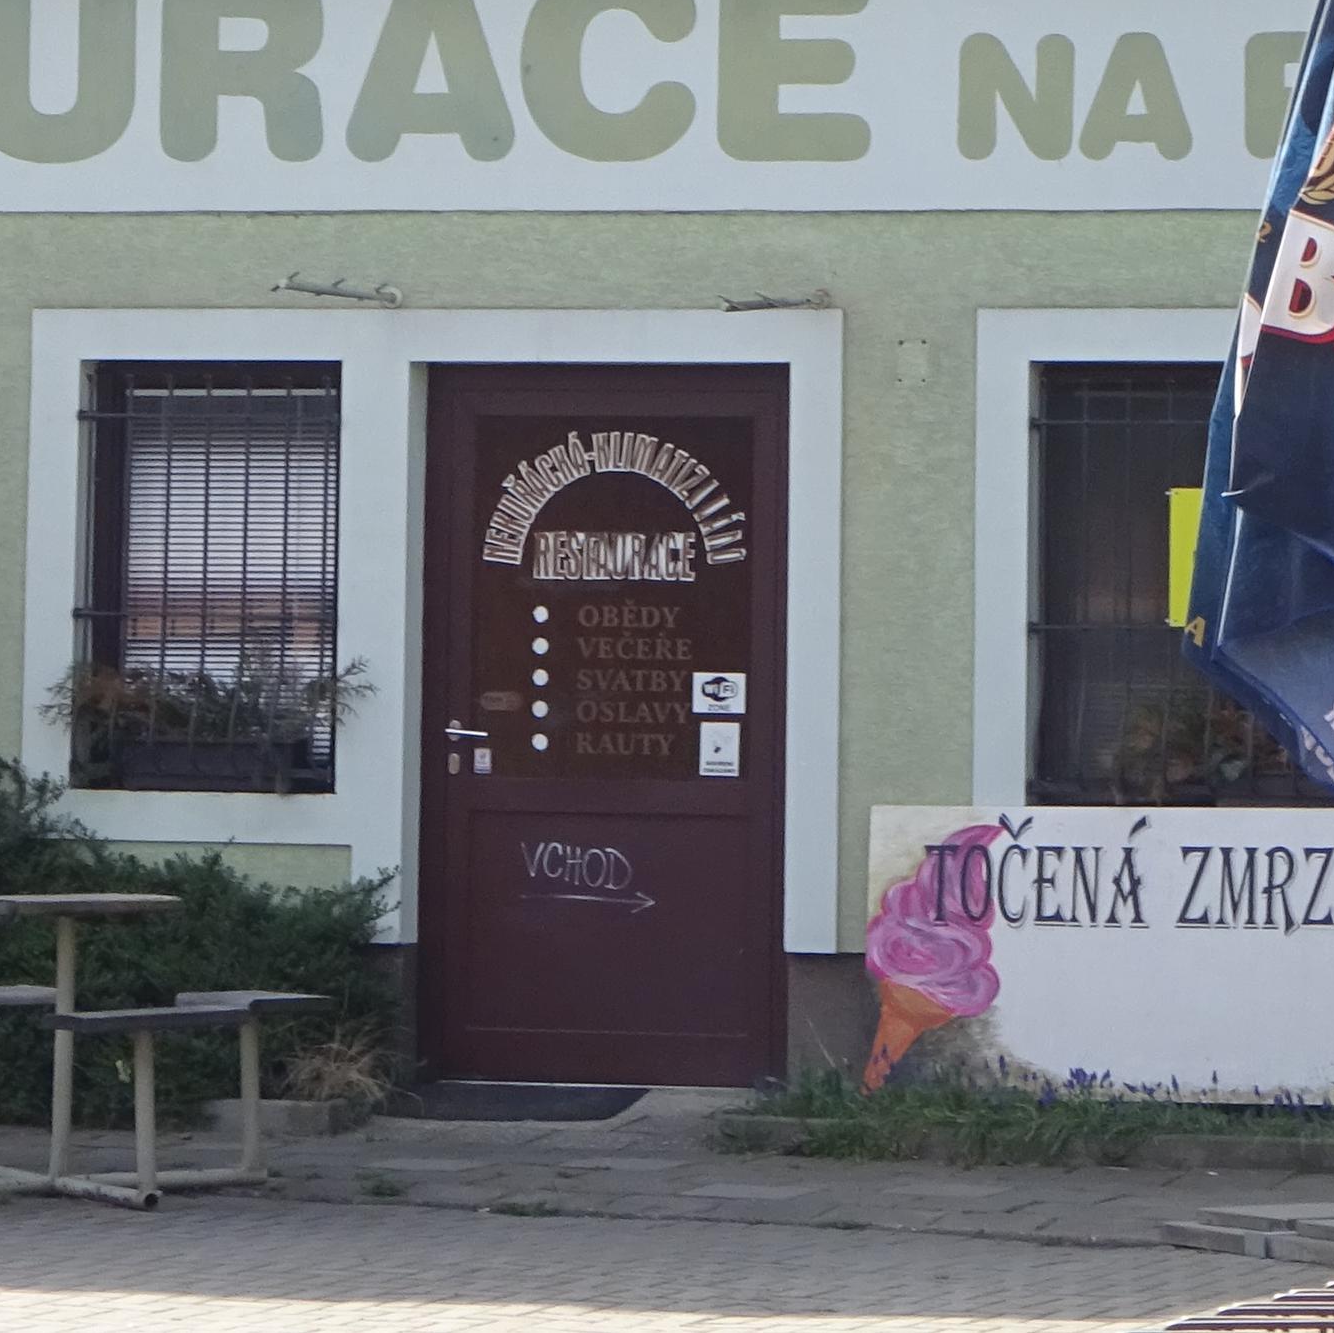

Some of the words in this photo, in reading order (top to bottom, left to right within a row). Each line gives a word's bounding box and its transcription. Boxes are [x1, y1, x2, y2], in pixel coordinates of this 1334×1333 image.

[956, 31, 1193, 161] NA
[532, 531, 696, 582] RESTAURACE
[578, 599, 680, 628] OBĚDY
[576, 669, 688, 692] SVATBY
[576, 701, 691, 724] OSLAVY
[521, 842, 633, 890] VCHOD
[924, 813, 1150, 927] TOČENÁ
